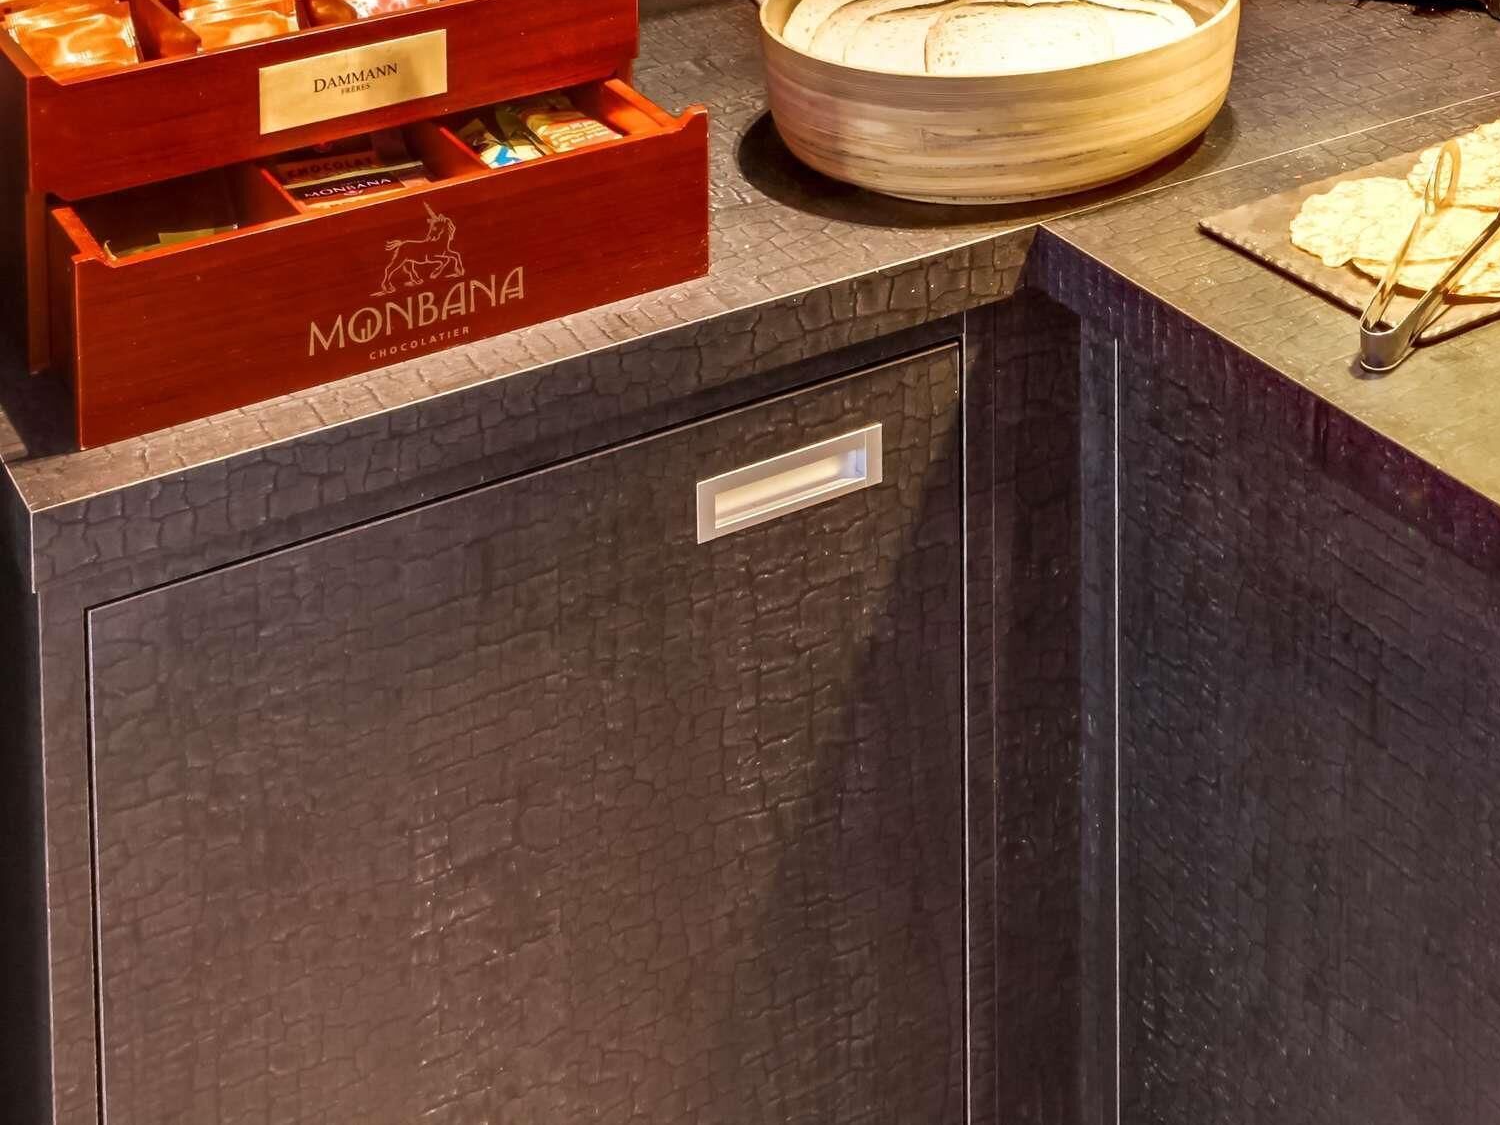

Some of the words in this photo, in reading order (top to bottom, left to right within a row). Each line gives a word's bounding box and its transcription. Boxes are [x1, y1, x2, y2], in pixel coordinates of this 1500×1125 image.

[313, 62, 399, 93] DAMMANN
[304, 178, 391, 198] MONBANA
[308, 266, 525, 357] MONBANA
[369, 326, 470, 361] CHOCOLATIER
